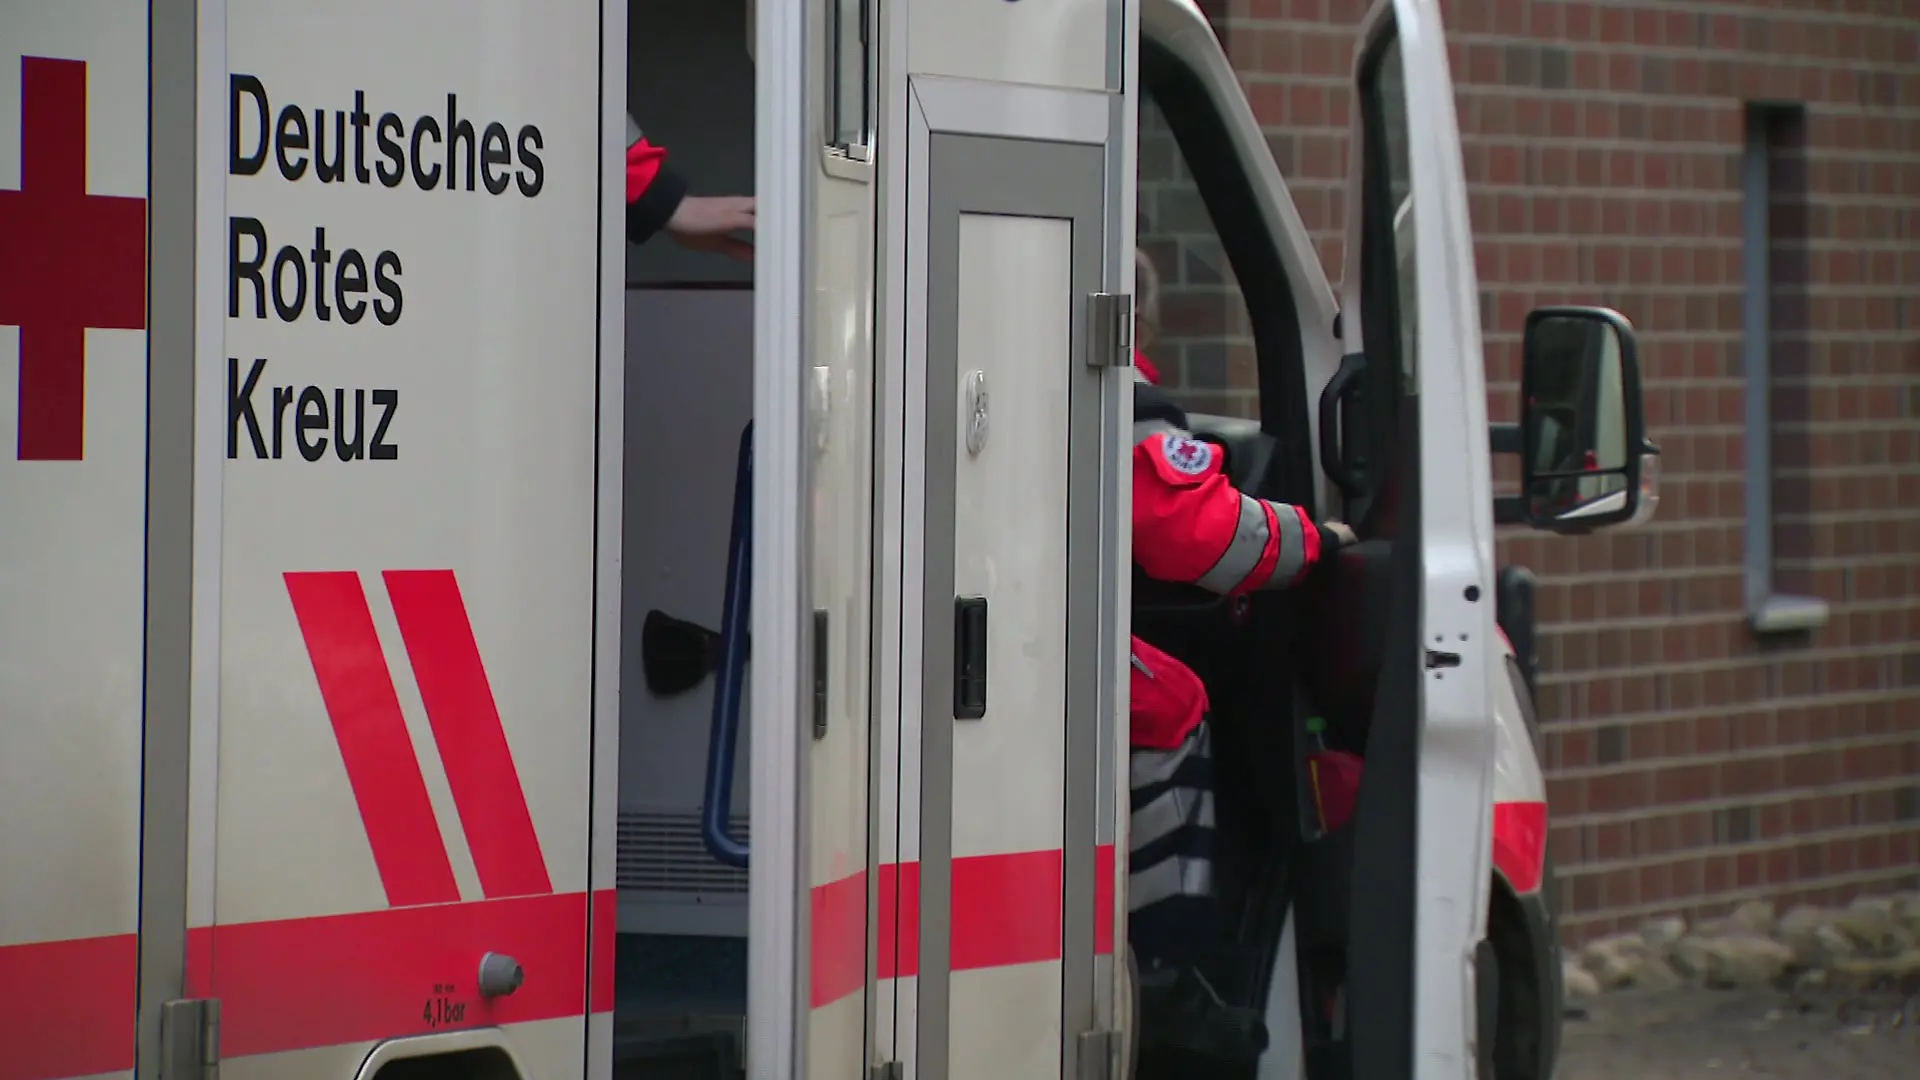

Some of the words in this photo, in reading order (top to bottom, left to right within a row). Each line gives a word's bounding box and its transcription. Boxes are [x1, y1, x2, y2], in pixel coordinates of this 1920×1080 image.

[228, 72, 545, 199] Deutsches
[228, 215, 404, 327] Rotes
[226, 357, 399, 463] Kreuz
